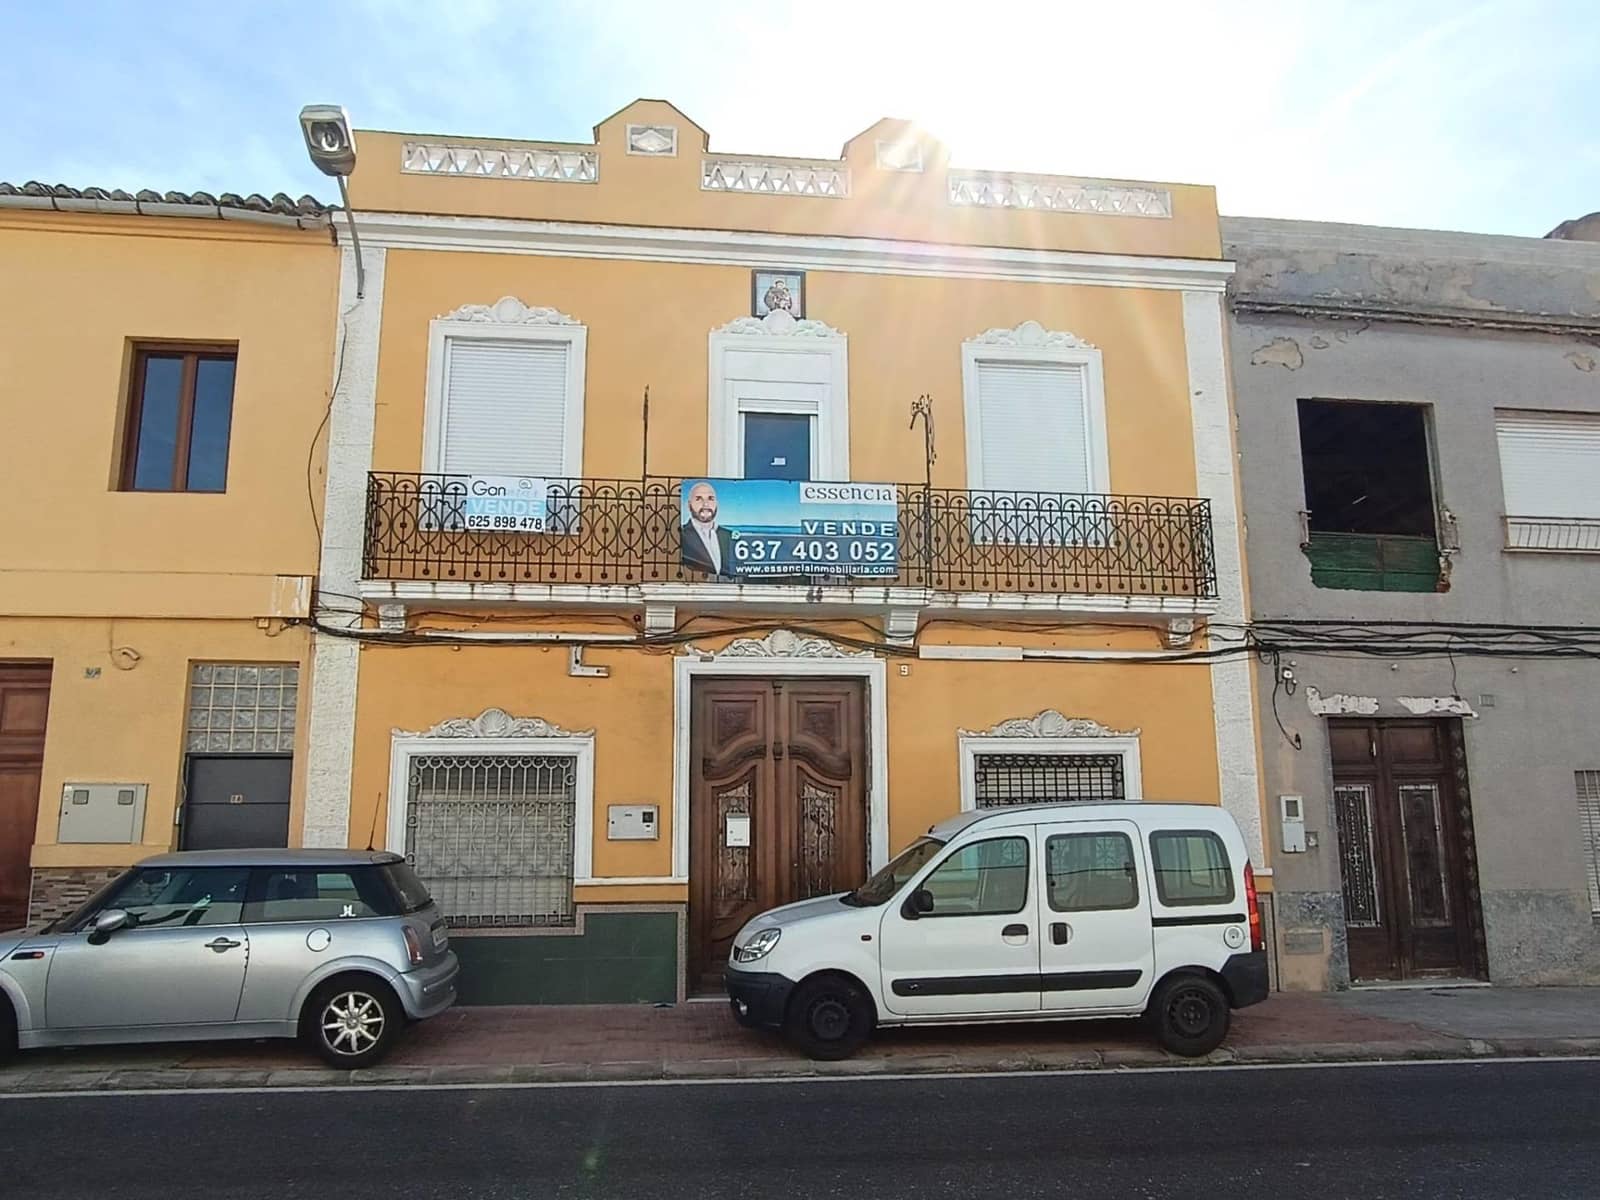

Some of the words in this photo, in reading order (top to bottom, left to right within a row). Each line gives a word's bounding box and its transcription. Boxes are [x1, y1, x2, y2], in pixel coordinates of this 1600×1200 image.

[804, 485, 893, 501] essencia
[470, 499, 541, 515] VENDE
[468, 515, 490, 528] 625
[494, 516, 517, 528] 898
[520, 517, 543, 530] 478
[804, 521, 895, 537] VENDE
[734, 540, 782, 560] 637
[792, 541, 839, 561] 403
[849, 541, 895, 561] 052
[736, 564, 894, 574] www.essenciainmobiliaria.com
